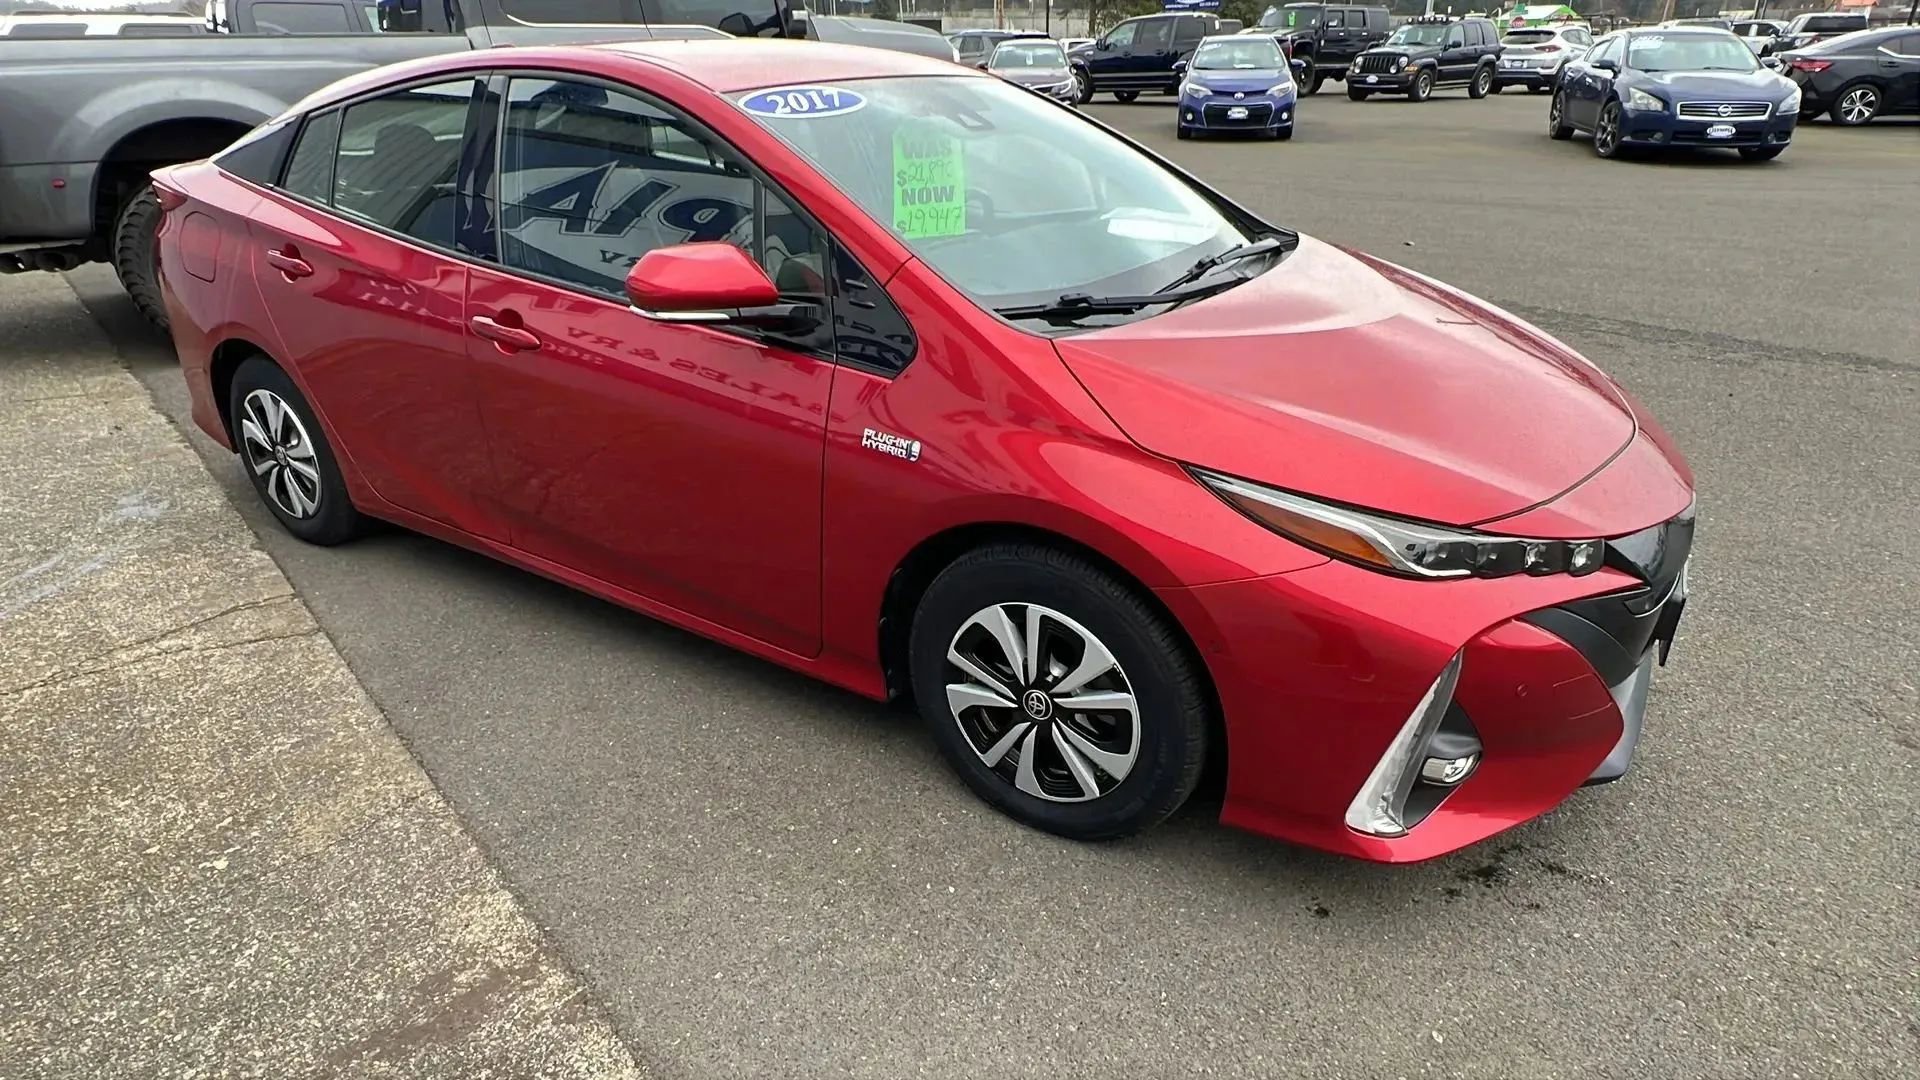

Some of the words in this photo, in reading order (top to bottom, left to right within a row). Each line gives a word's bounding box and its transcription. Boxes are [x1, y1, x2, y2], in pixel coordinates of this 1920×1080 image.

[767, 90, 840, 114] 2017
[902, 185, 955, 206] NOW
[862, 437, 908, 459] HYBRID
[864, 428, 911, 450] PLUG-IN
